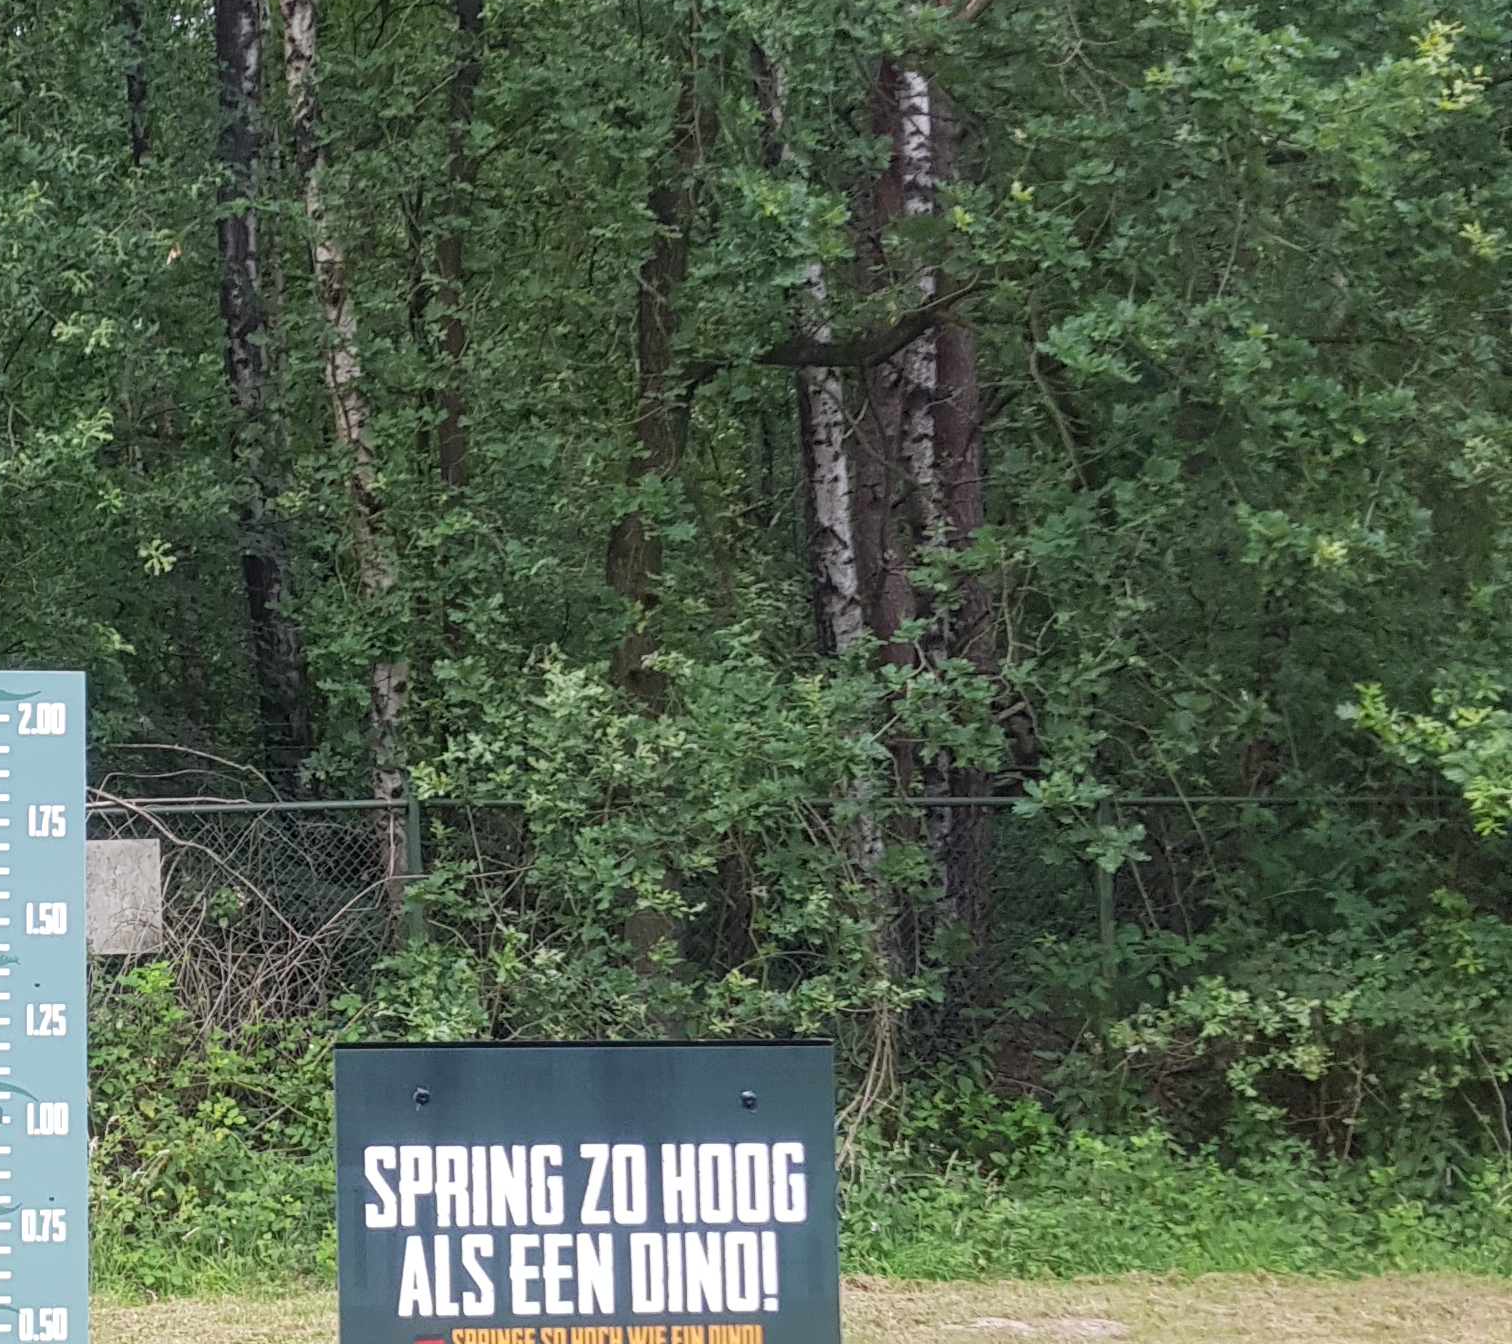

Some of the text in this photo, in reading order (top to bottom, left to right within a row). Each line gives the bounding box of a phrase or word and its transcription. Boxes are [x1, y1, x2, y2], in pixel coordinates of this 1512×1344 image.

[18, 702, 66, 735] 2.00
[28, 805, 66, 837] 1.75
[26, 902, 67, 935] 1.50
[26, 1003, 66, 1036] 1.25
[27, 1102, 69, 1135] 1.00
[364, 1141, 807, 1229] SPRING ZO HOOG
[21, 1209, 66, 1242] 0.75
[397, 1230, 779, 1318] ALS EEN DINO!
[18, 1307, 68, 1341] 0.50
